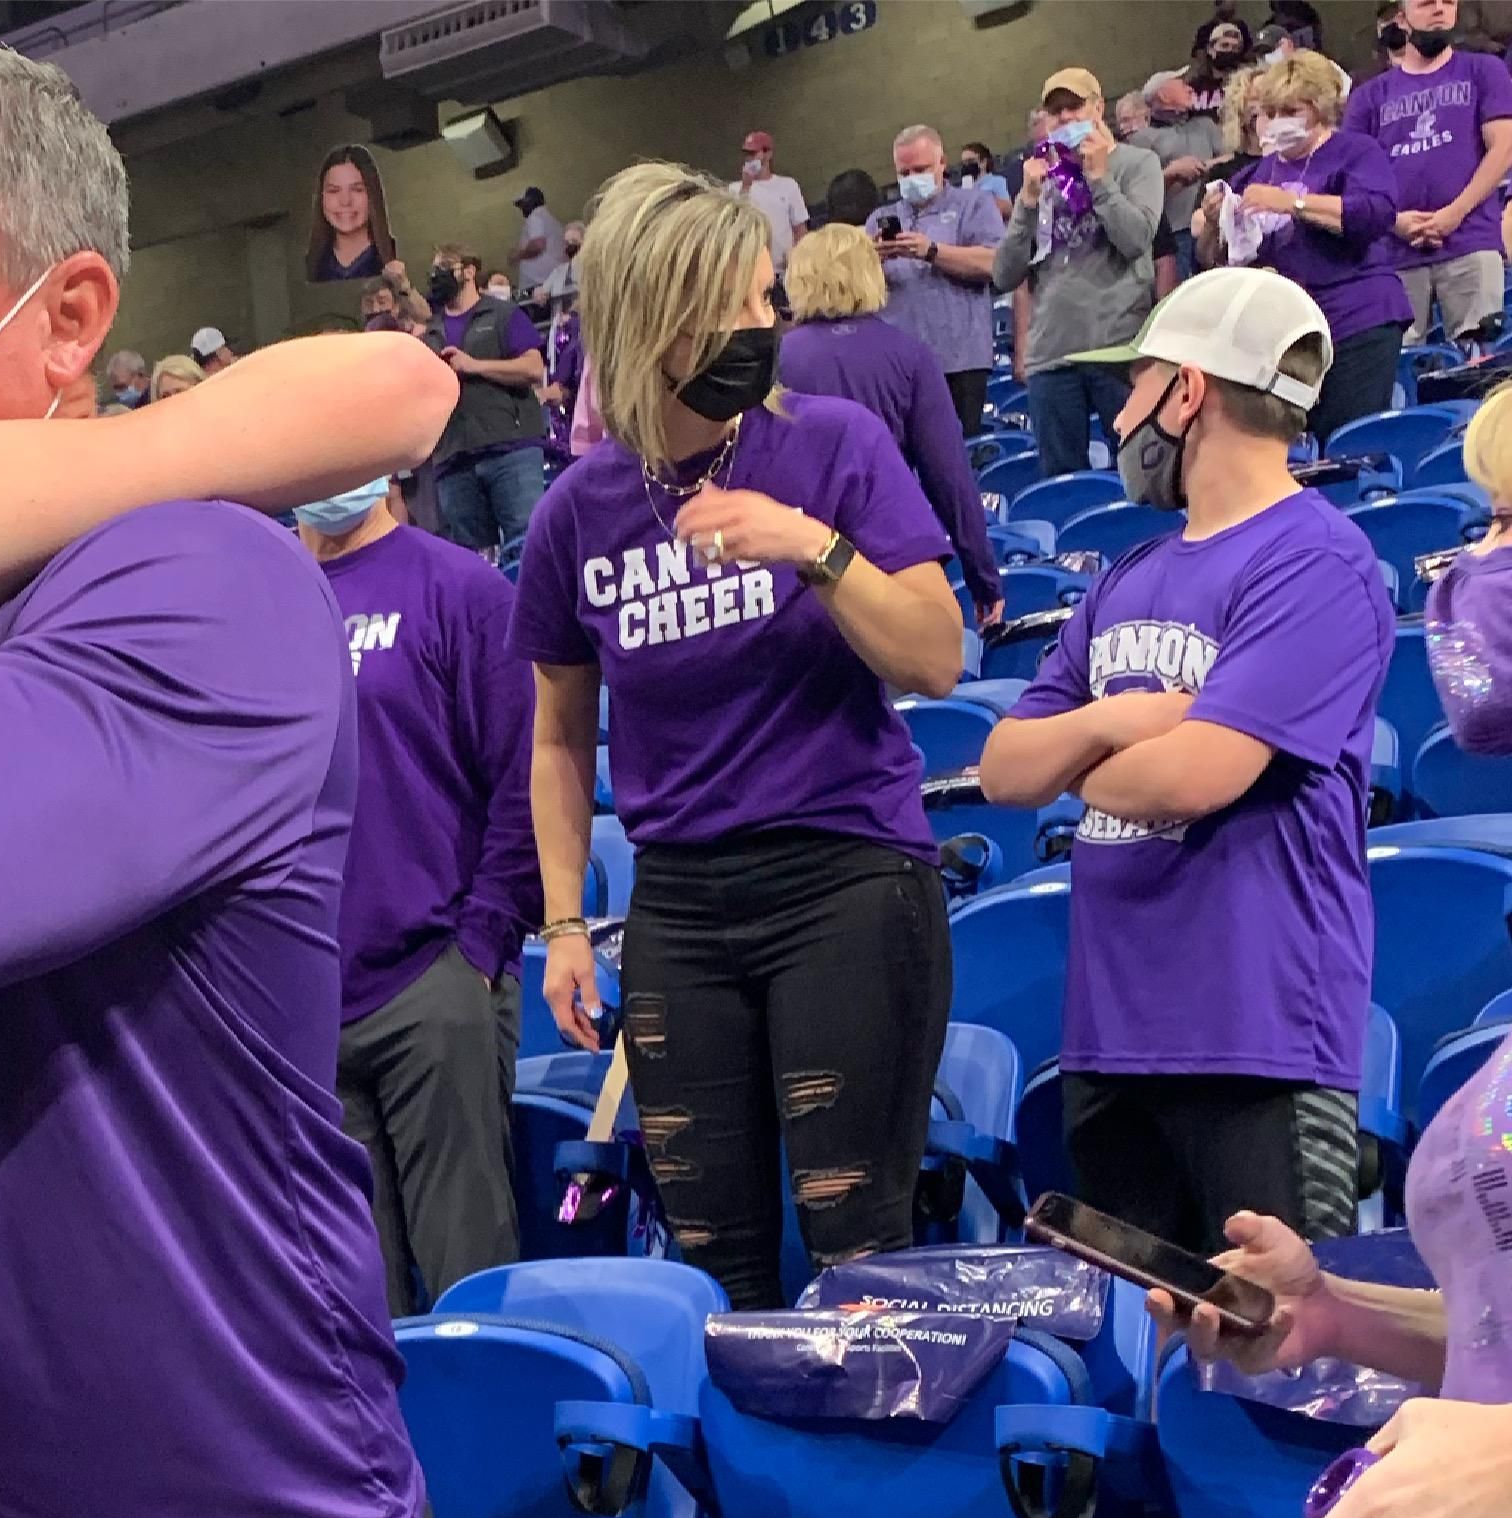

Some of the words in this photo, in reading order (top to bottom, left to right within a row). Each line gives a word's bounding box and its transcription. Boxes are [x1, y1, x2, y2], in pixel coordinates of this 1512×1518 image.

[1379, 80, 1471, 126] CANYON
[1390, 130, 1453, 157] EAGLES
[583, 539, 761, 608] CAN
[618, 568, 775, 650] CHEER
